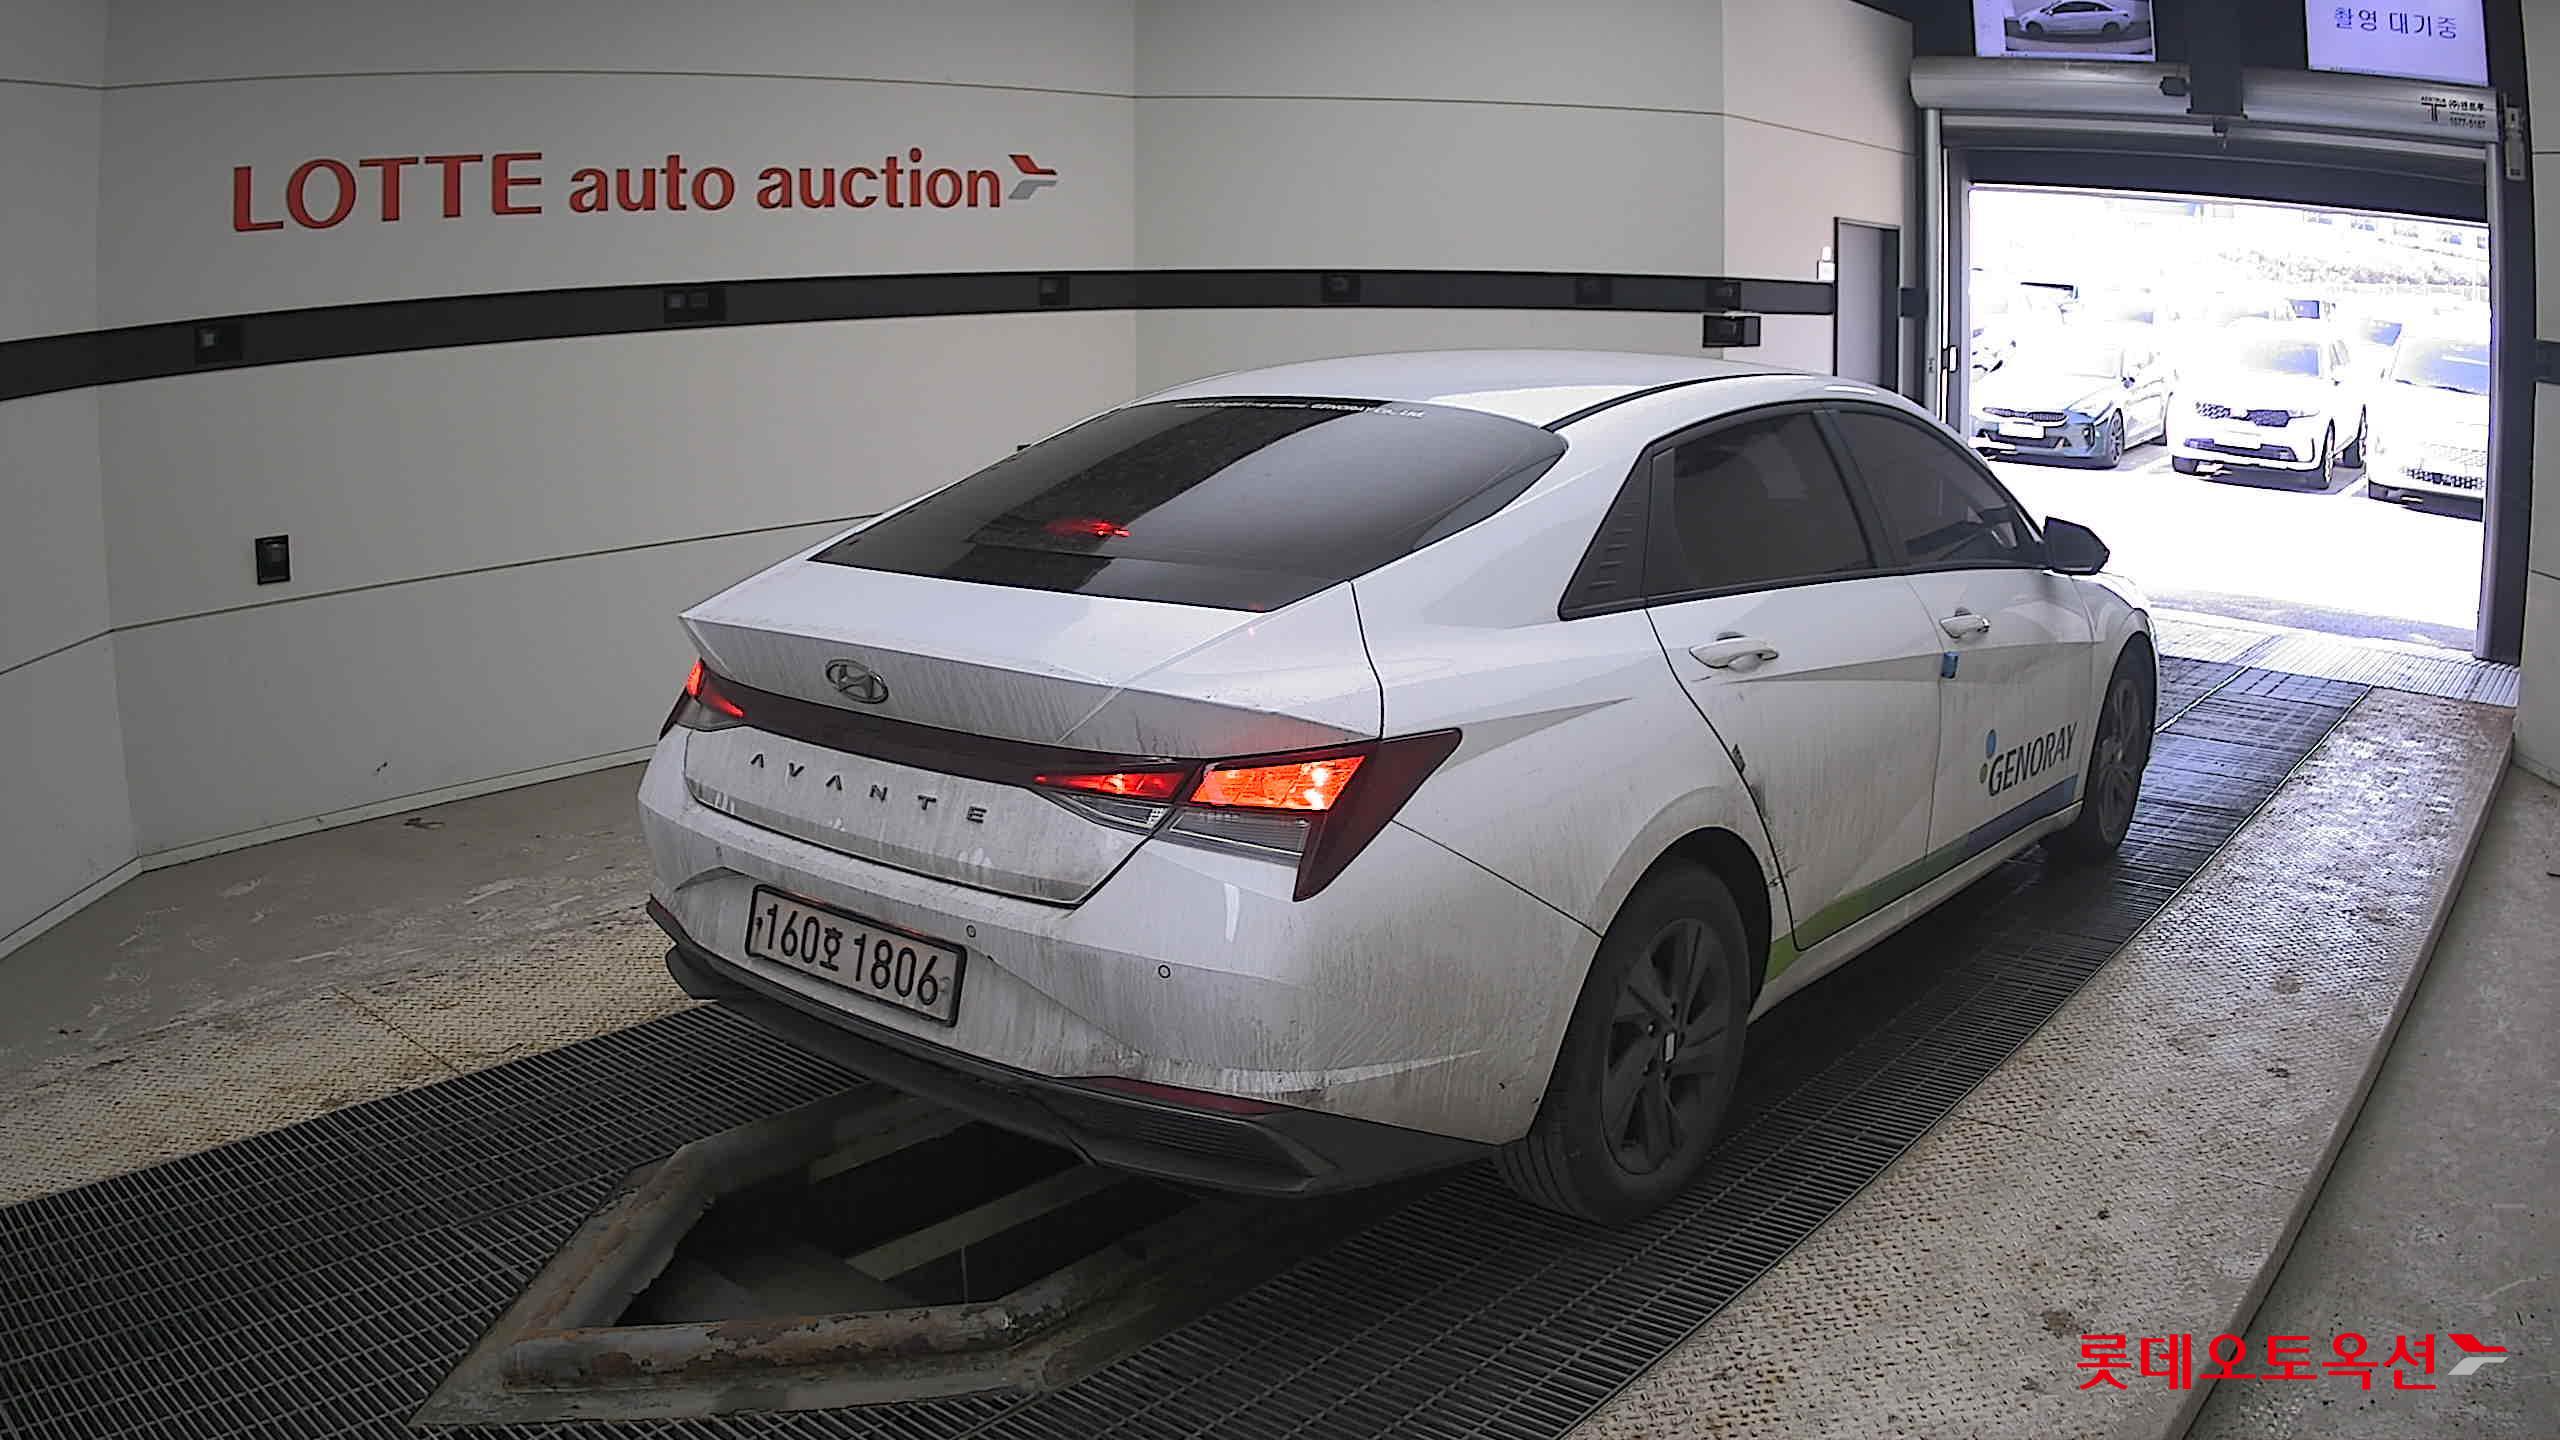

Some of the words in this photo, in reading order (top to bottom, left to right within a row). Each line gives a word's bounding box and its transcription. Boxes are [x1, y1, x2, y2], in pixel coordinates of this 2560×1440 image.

[2388, 12, 2458, 40] 대기중
[233, 152, 542, 233] LOTTE
[568, 154, 736, 213] auto
[757, 147, 1002, 210] auction
[749, 752, 988, 824] AVANTE
[1988, 722, 2079, 797] GENORAY
[766, 903, 845, 972] 160호
[853, 932, 939, 1006] 1806
